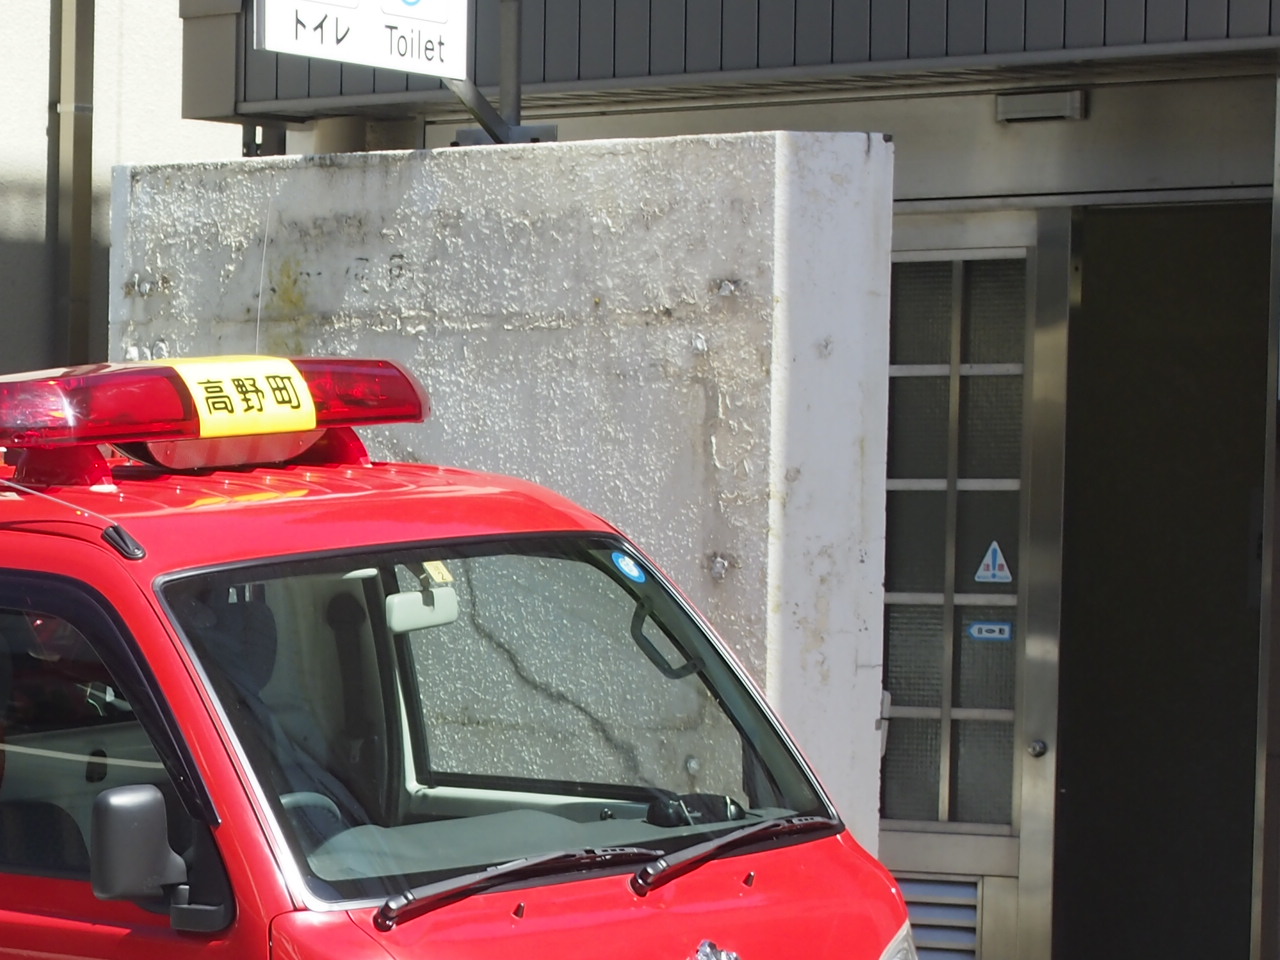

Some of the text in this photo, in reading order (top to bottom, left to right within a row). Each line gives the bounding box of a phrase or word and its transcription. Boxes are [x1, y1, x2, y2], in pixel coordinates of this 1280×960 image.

[295, 9, 350, 45] トイレ
[385, 24, 445, 63] Toilet
[196, 374, 301, 416] 高野町
